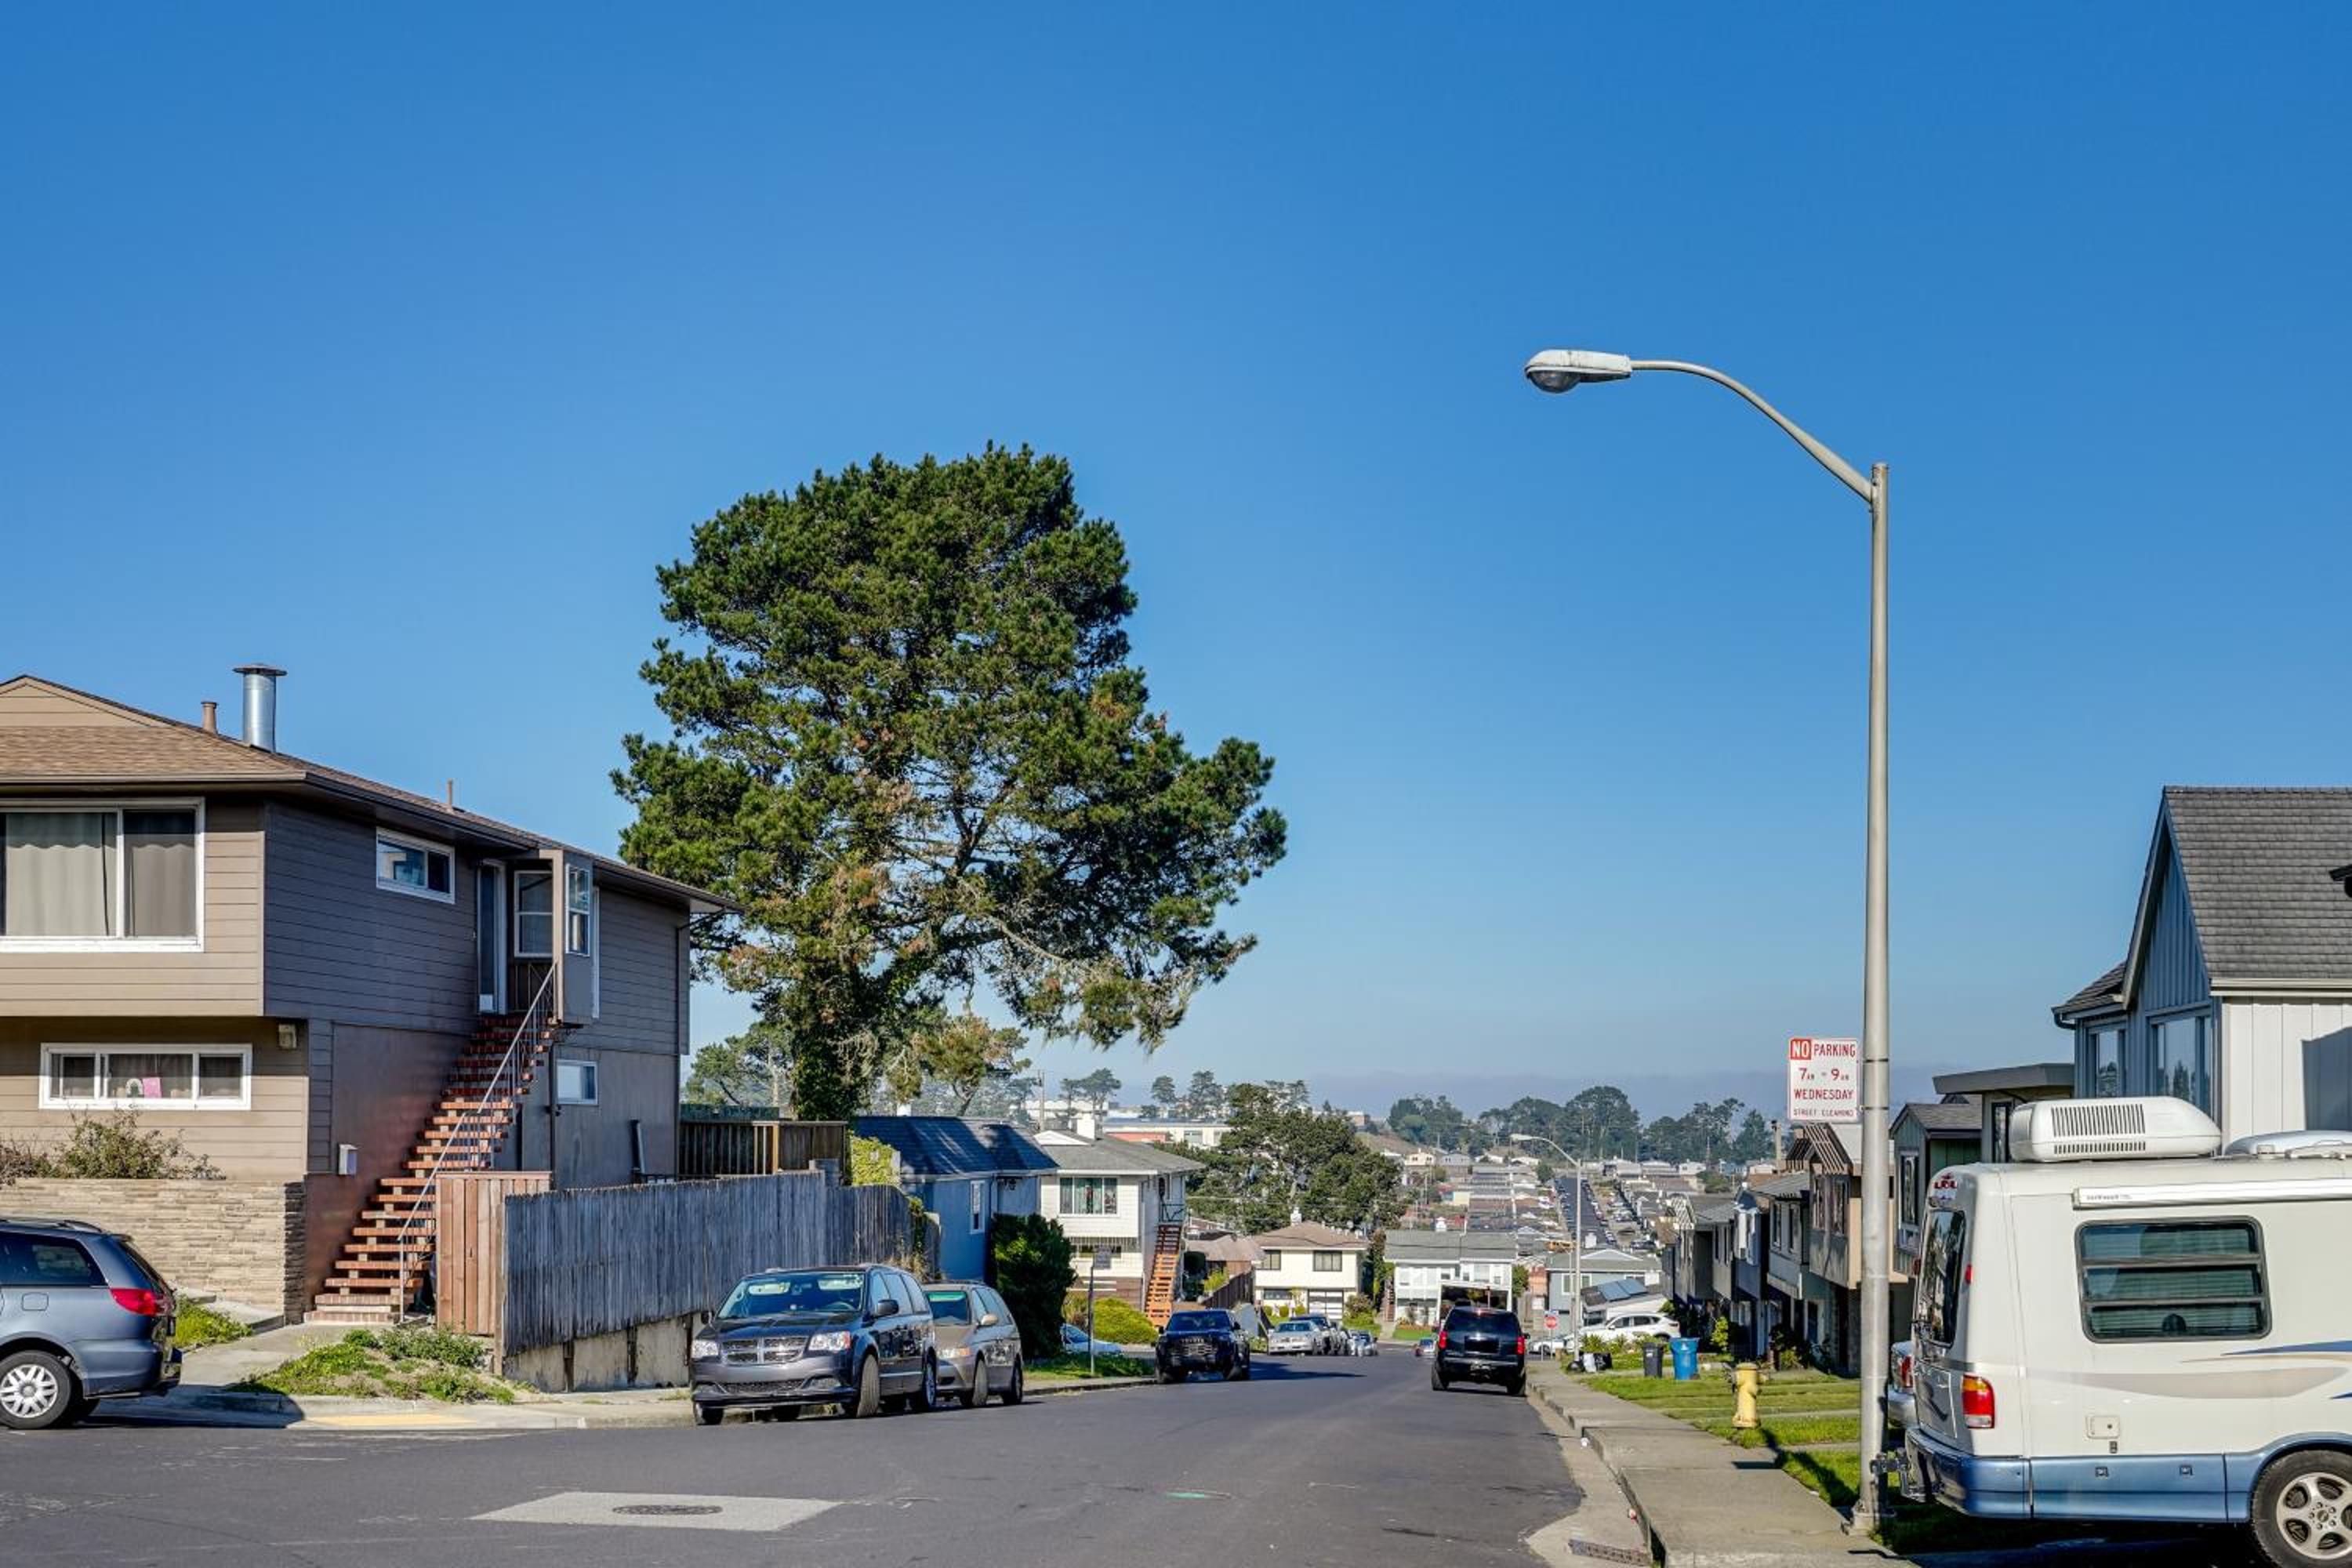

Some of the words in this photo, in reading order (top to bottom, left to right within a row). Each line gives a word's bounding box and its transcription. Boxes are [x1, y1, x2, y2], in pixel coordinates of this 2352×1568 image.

[1792, 1040, 1810, 1058] NO
[1813, 1044, 1856, 1058] PARKING
[1794, 1088, 1853, 1100] WEDNESDAY
